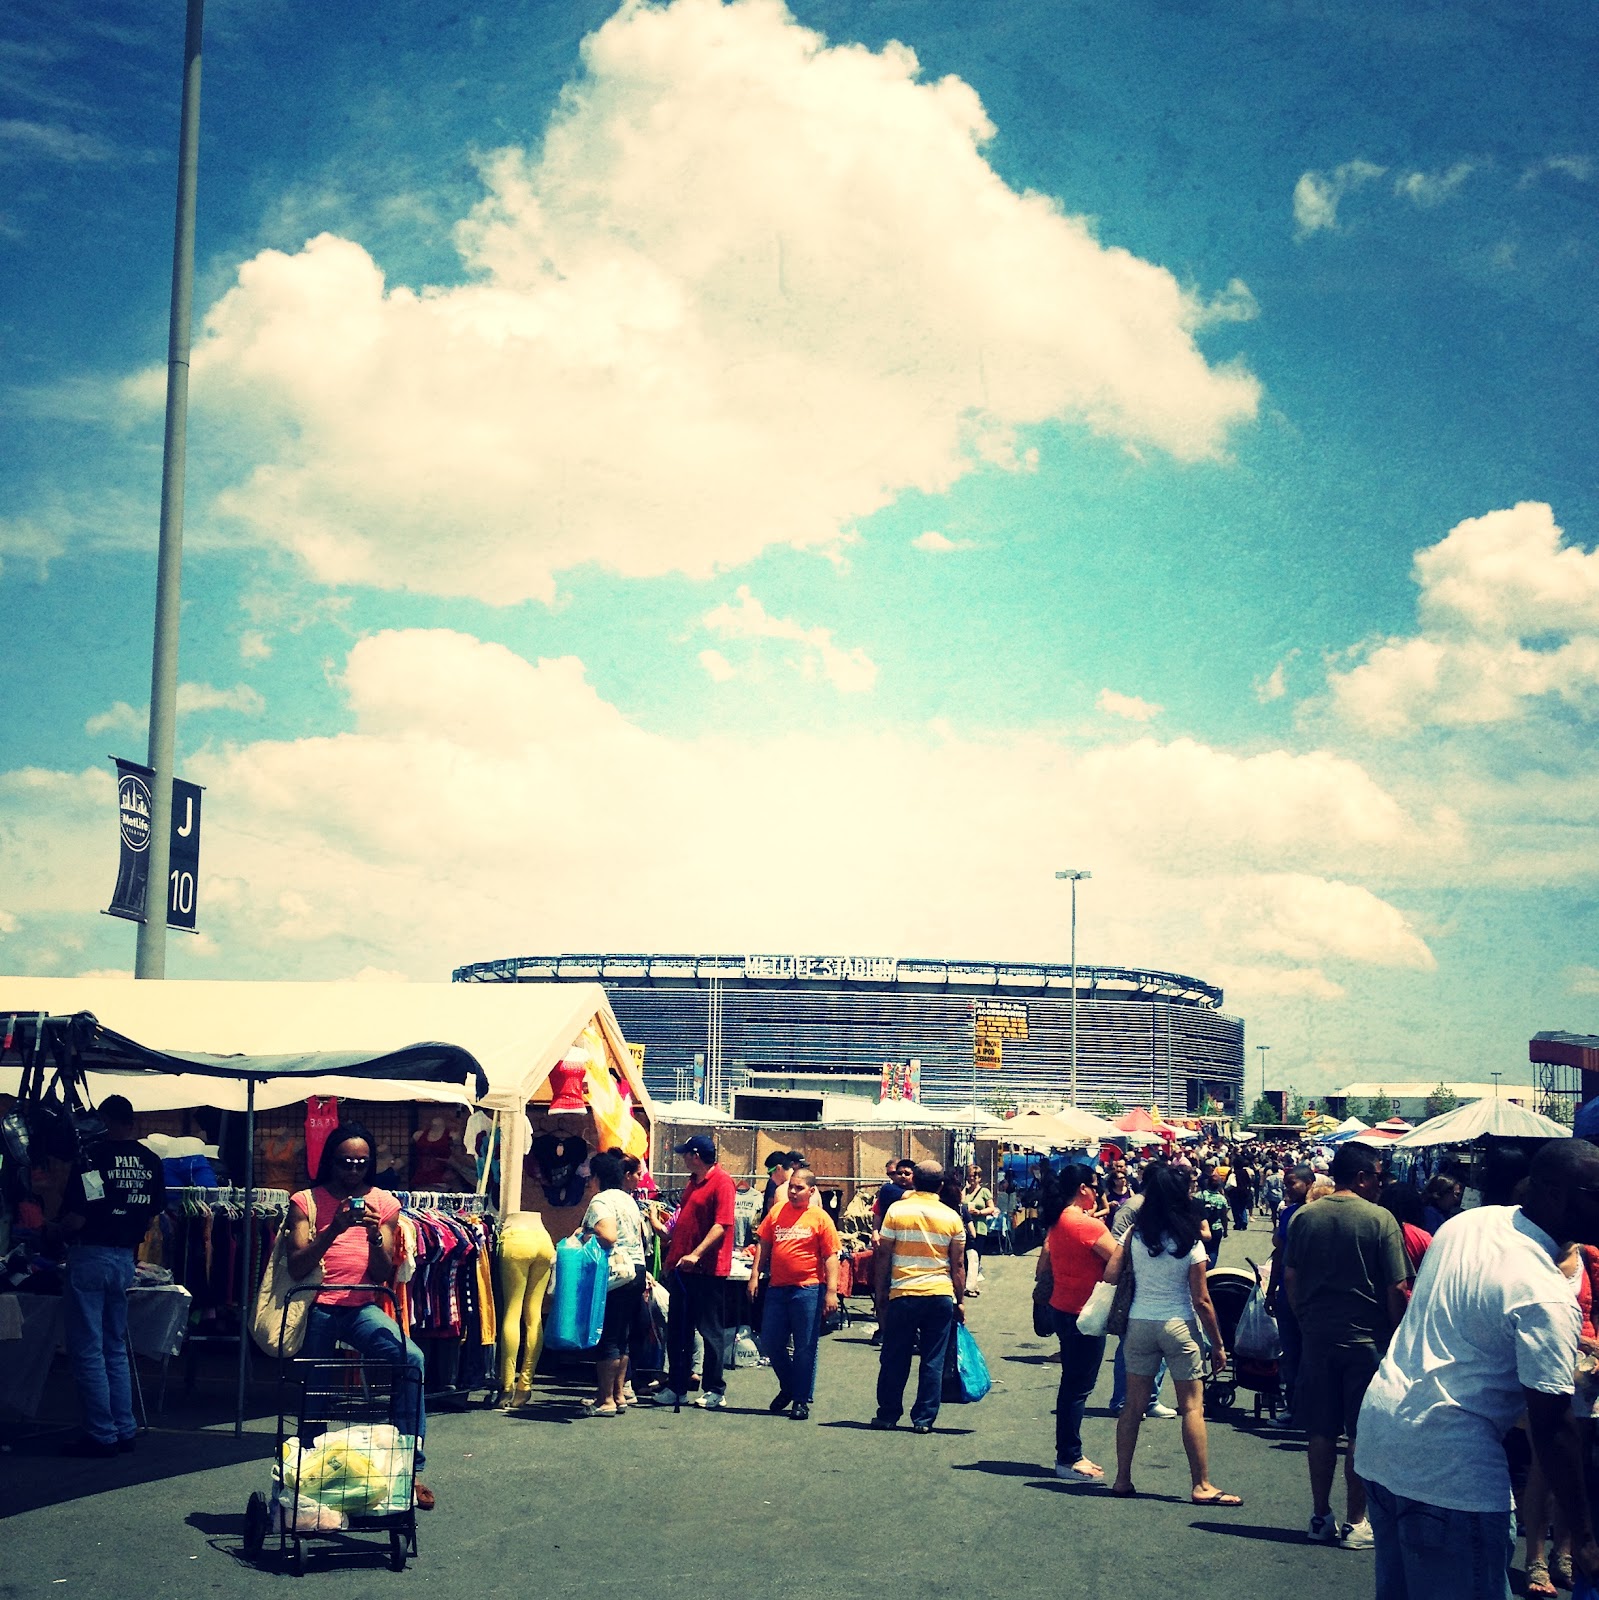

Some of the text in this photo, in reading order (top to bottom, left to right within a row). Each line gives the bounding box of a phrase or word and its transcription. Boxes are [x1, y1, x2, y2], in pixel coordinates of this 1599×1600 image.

[122, 813, 149, 832] MetLife
[177, 797, 193, 838] J
[170, 869, 194, 914] 10
[746, 955, 898, 978] METLIFE STADIUM
[115, 1156, 140, 1168] PAIN
[107, 1169, 153, 1180] WEAKNESS
[126, 1194, 151, 1205] BODY
